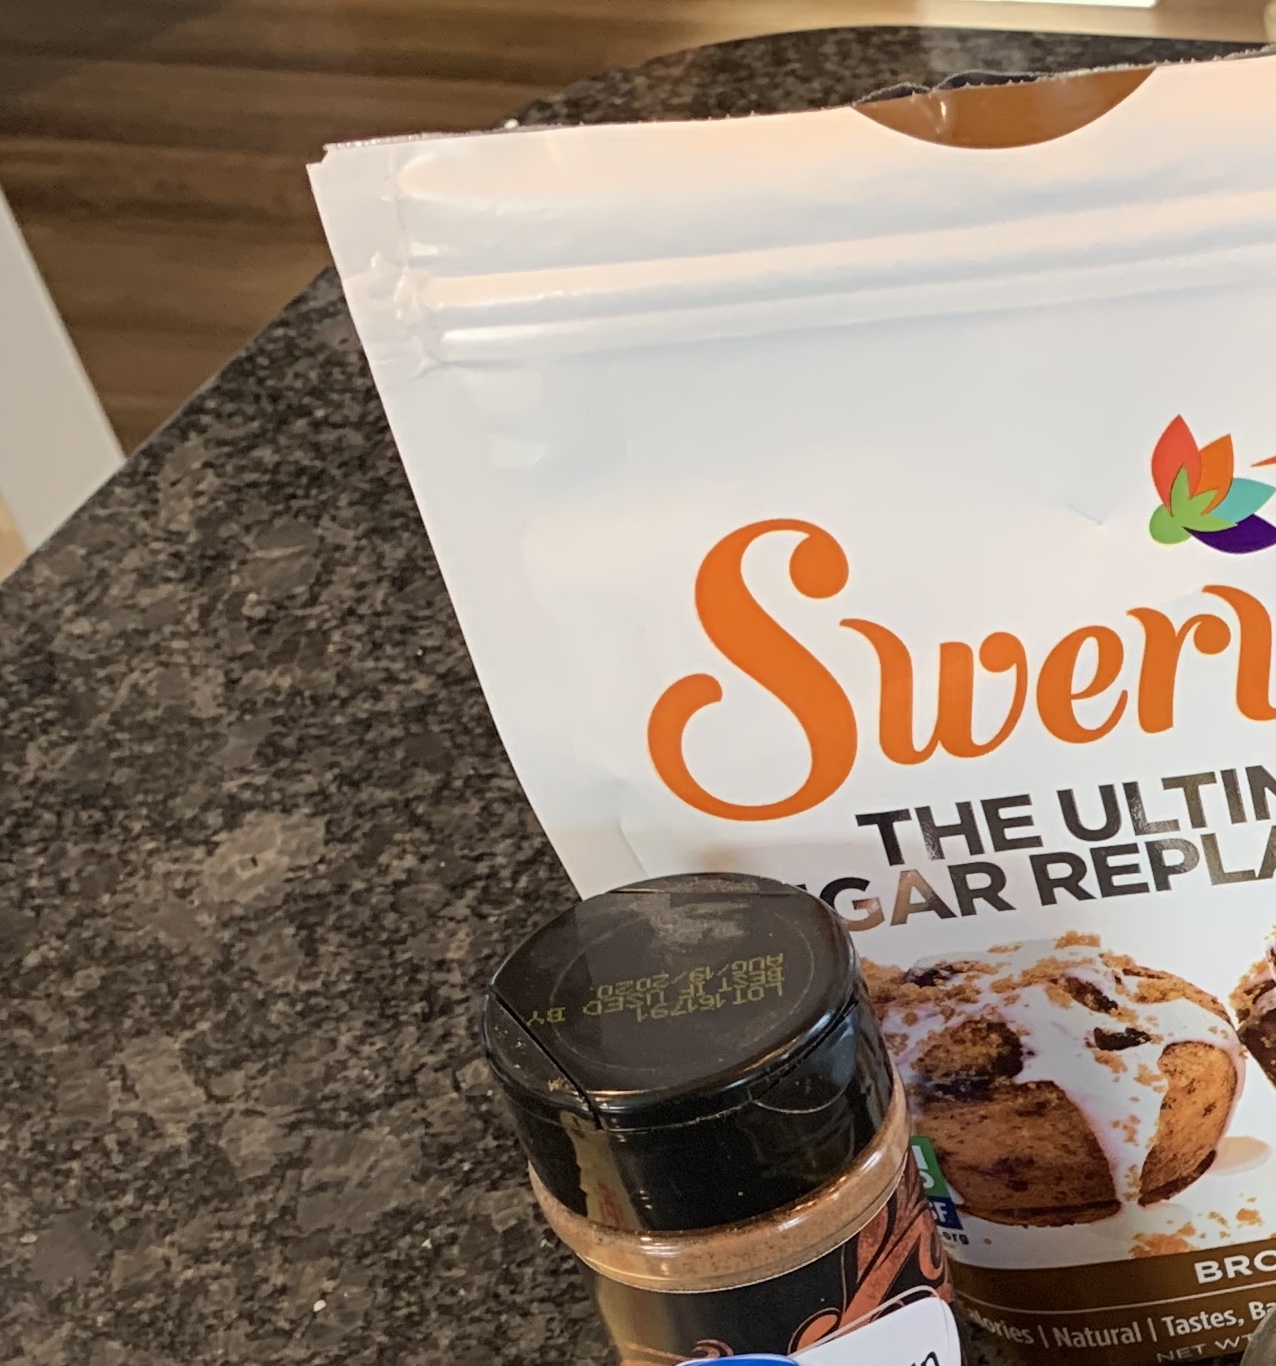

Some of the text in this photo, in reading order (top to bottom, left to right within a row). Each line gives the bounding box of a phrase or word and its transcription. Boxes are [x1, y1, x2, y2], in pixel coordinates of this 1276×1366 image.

[855, 794, 1044, 867] THE
[799, 862, 1016, 932] GAR
[527, 967, 785, 1026] BEST IF USED BY
[731, 982, 784, 1006] LOT
[1052, 1322, 1142, 1348] Natural
[1161, 1309, 1245, 1337] Tastes,
[1156, 1343, 1206, 1363] NET
